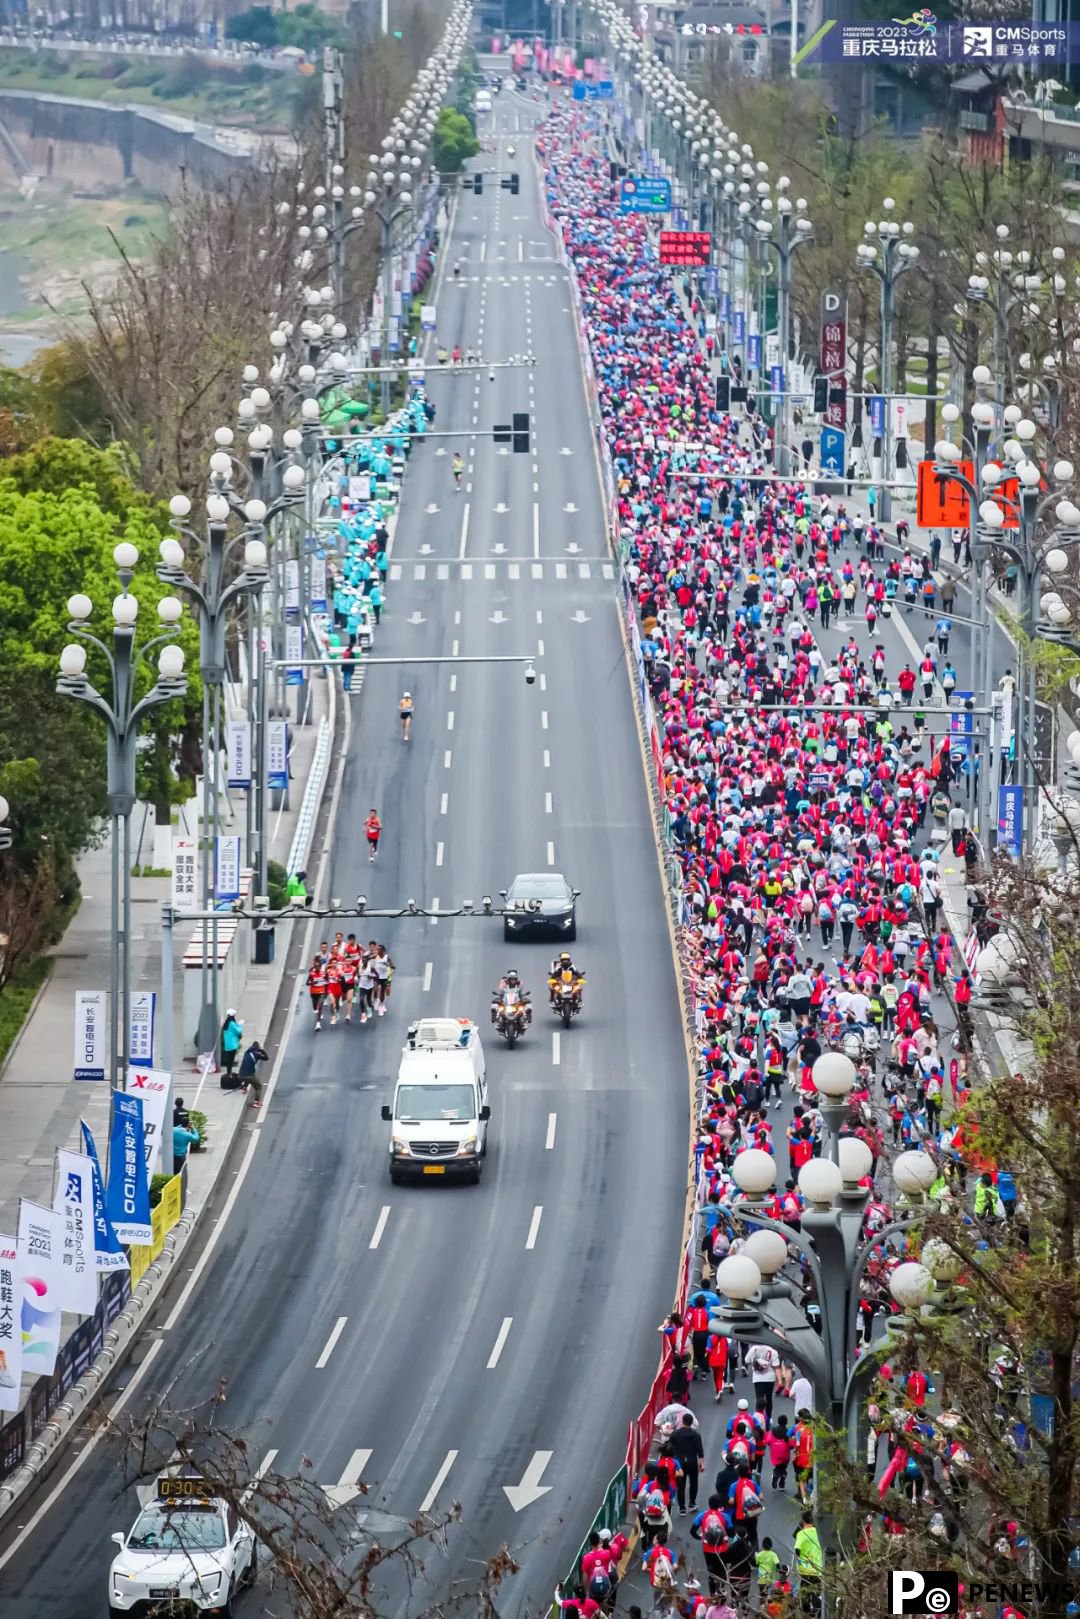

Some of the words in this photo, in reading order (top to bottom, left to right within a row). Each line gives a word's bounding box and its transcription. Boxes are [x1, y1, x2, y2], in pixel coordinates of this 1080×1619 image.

[825, 294, 840, 311] D
[826, 435, 838, 449] P
[0, 1268, 13, 1340] 跑鞋大奖
